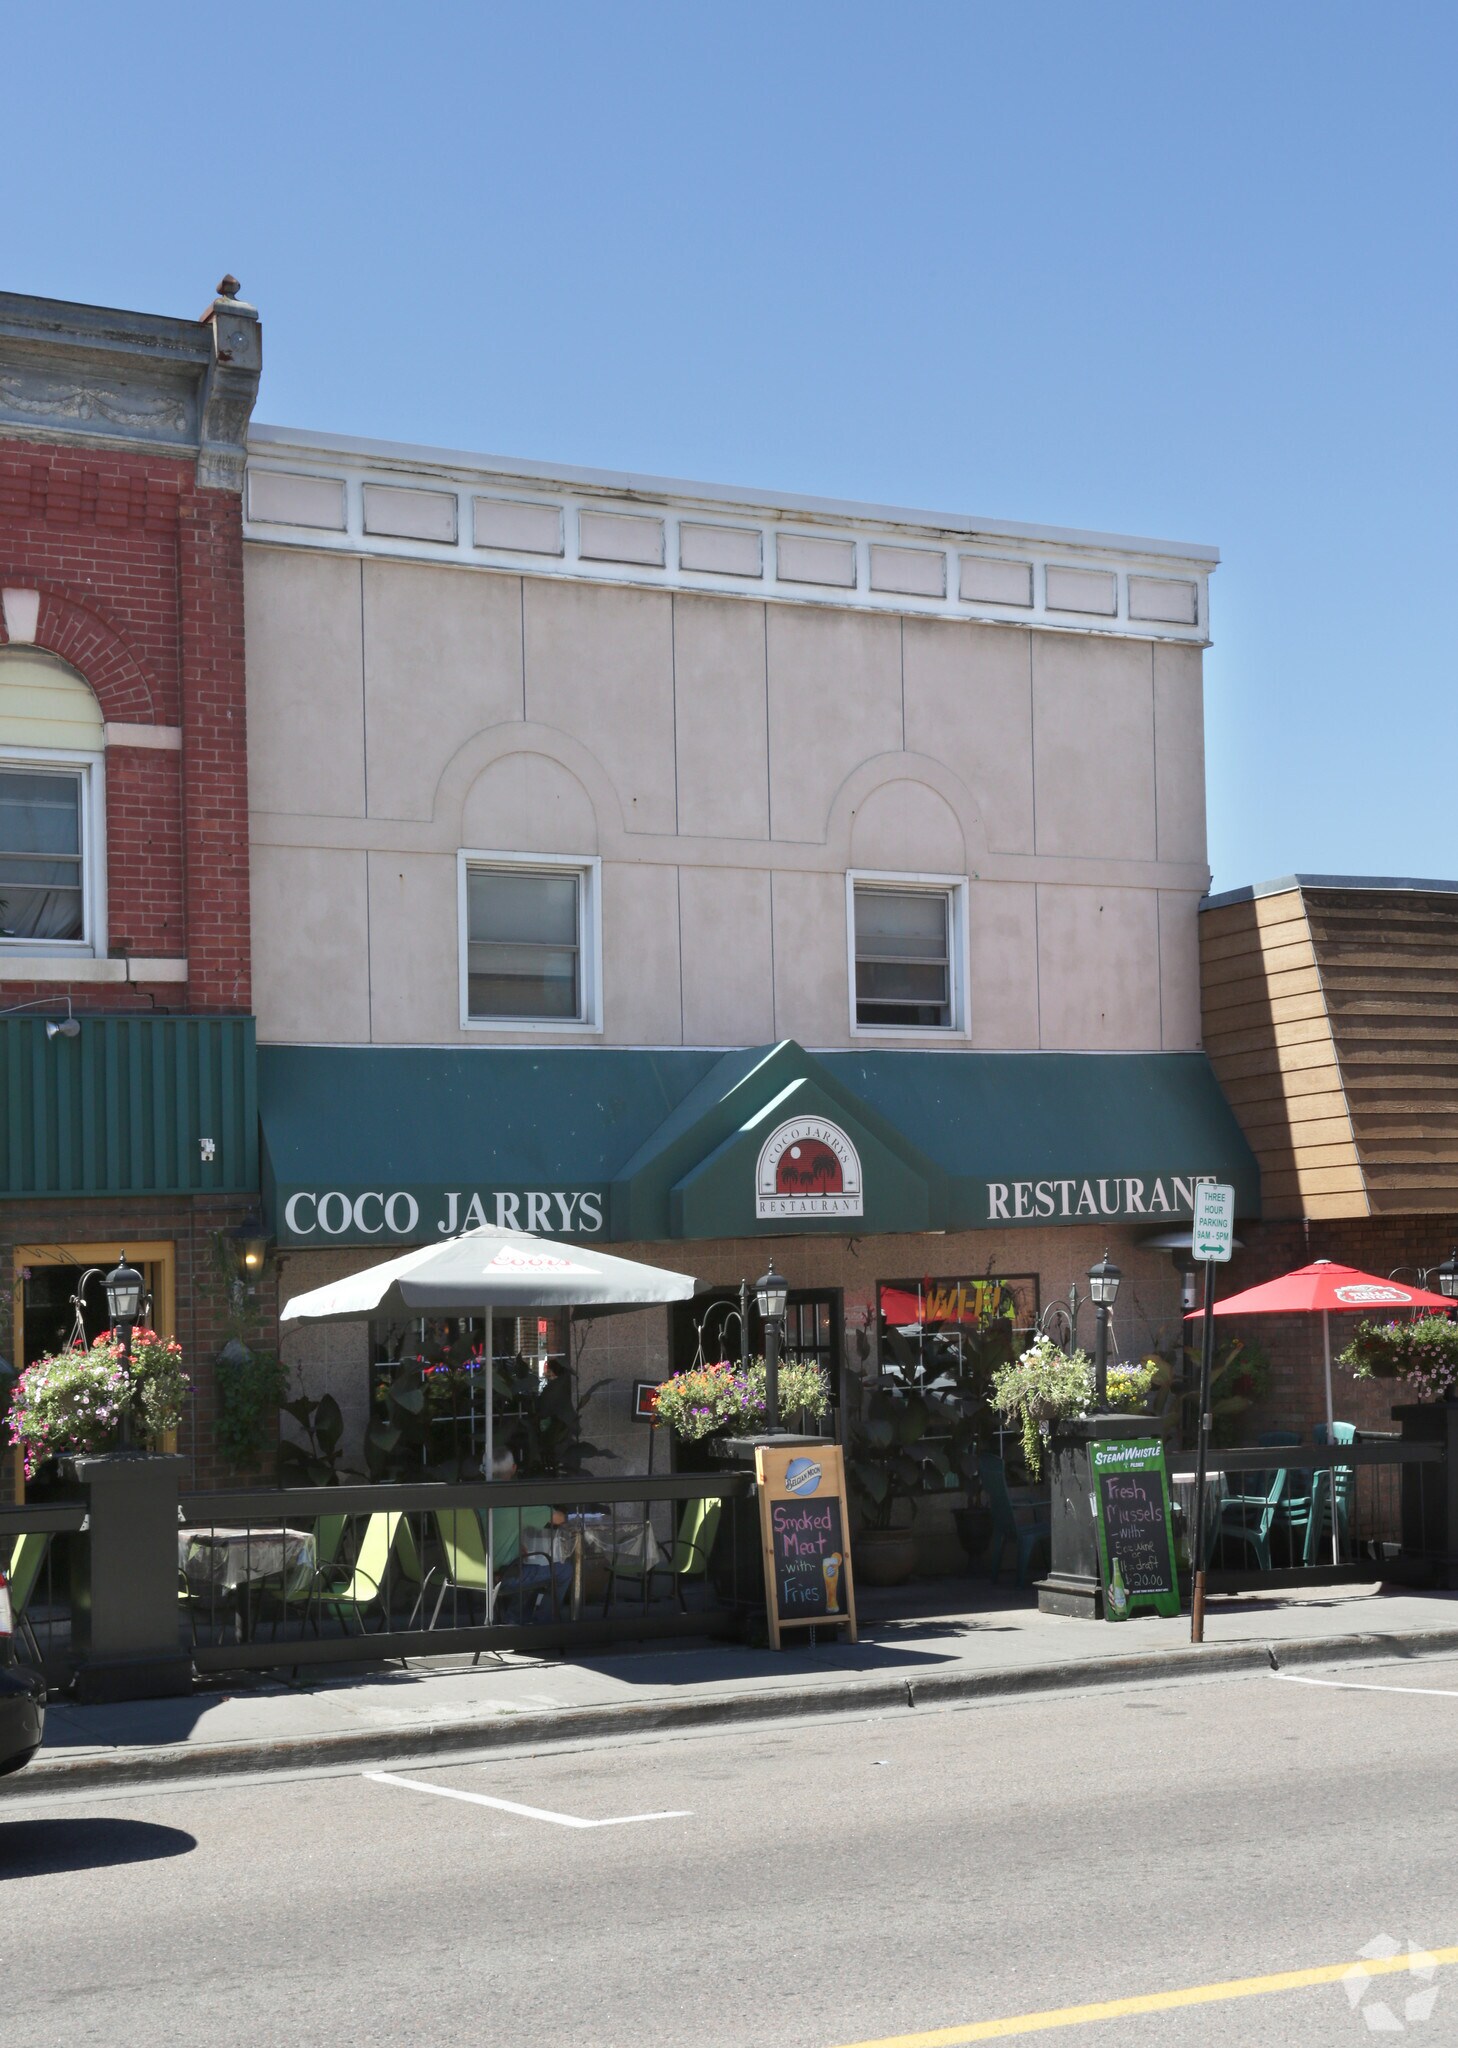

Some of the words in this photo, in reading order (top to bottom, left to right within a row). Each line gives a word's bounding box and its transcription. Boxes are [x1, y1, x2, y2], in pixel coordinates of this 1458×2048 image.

[769, 1128, 800, 1164] COCO
[805, 1126, 850, 1164] JARRYS
[759, 1199, 860, 1212] RESTAURANT
[1204, 1192, 1226, 1202] THREE
[284, 1191, 419, 1235] COCO
[437, 1191, 604, 1233] JARRYS
[1204, 1205, 1224, 1215] HOUR
[1199, 1217, 1228, 1228] PARKING
[1197, 1230, 1211, 1240] 9AM
[1216, 1231, 1229, 1241] 5PM
[1105, 1476, 1146, 1501] Fresh
[774, 1507, 832, 1533] Smoked
[1106, 1501, 1163, 1524] Mussels
[783, 1532, 828, 1557] Meat
[1135, 1555, 1159, 1571] draft
[783, 1577, 820, 1604] Fries
